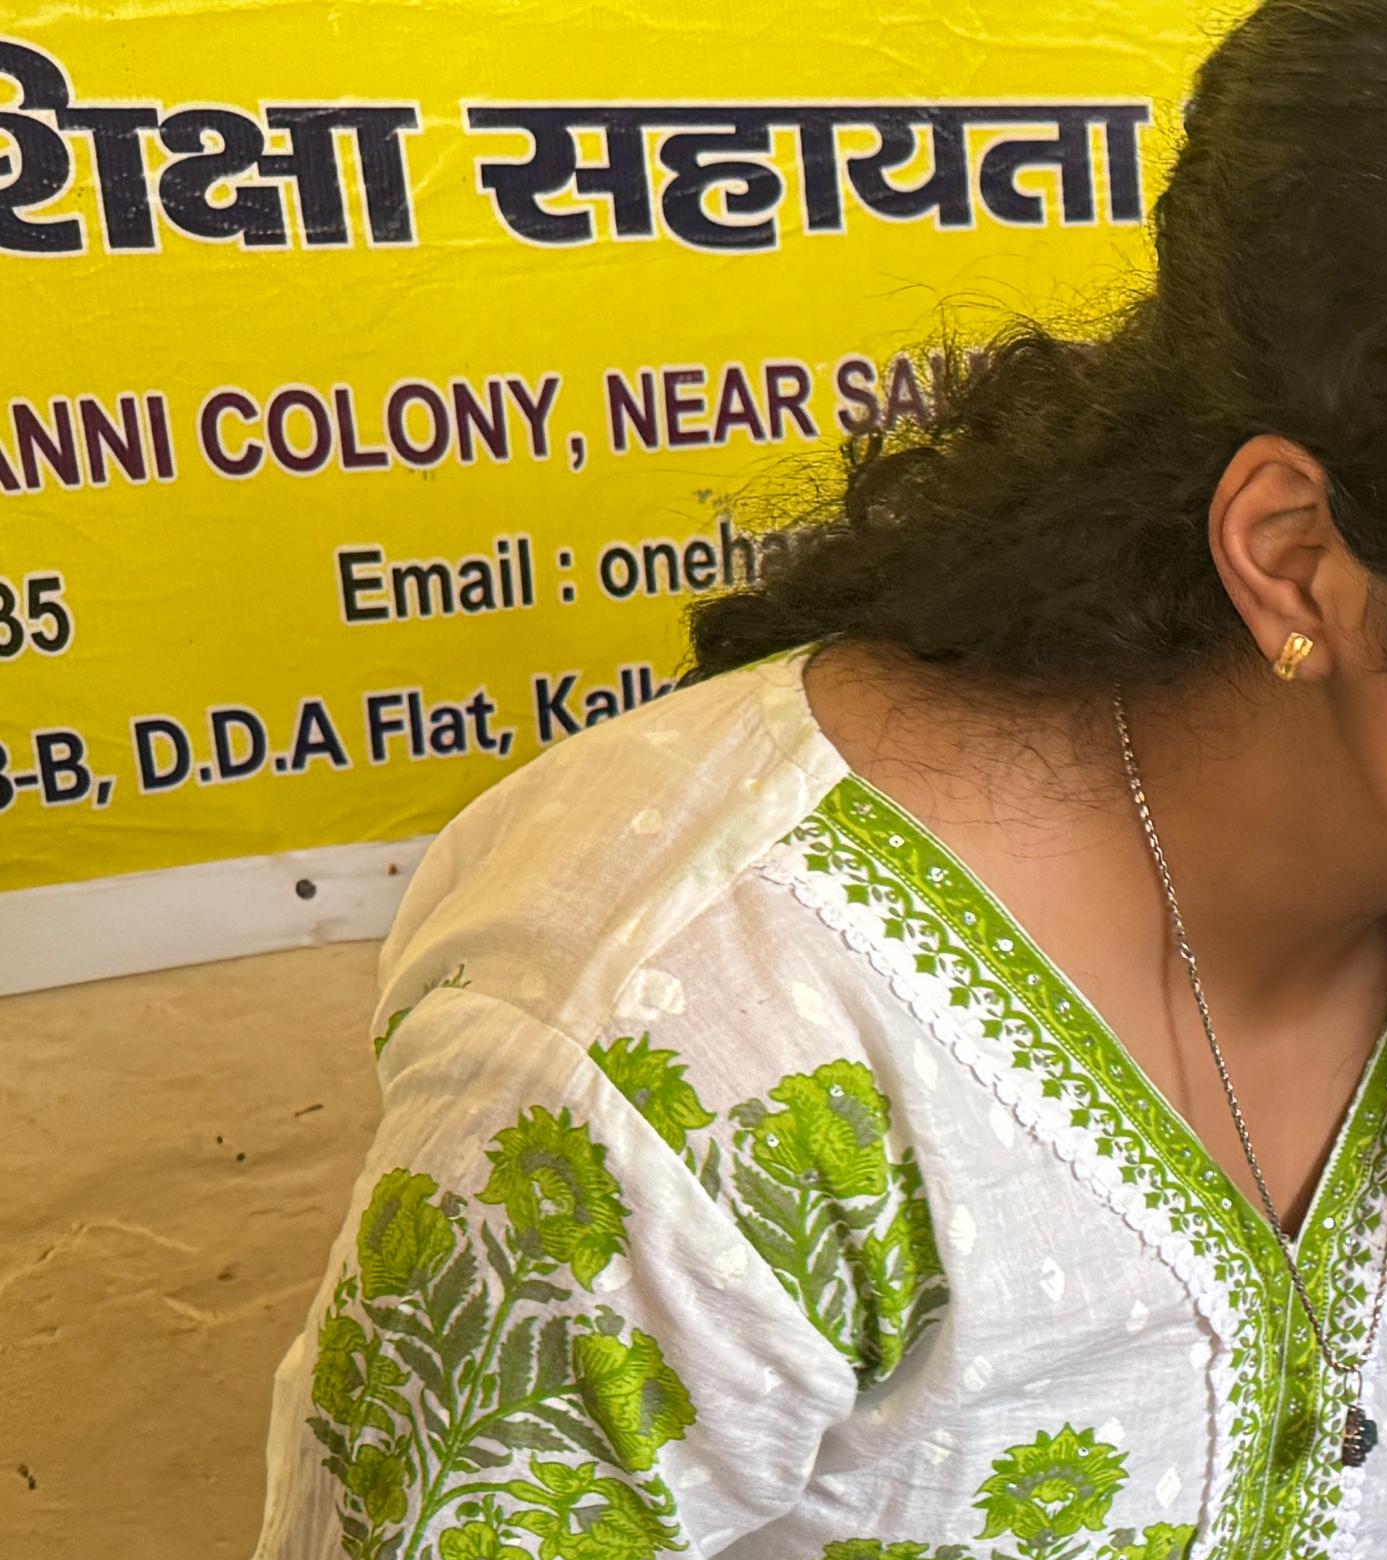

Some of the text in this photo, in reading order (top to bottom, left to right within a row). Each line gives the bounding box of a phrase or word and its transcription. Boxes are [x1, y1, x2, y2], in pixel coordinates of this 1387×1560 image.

[463, 102, 1149, 248] सहायता
[200, 372, 586, 474] COLONY,
[607, 360, 816, 453] NEAR
[337, 536, 533, 623] Email
[134, 699, 347, 793] D.D.A
[367, 687, 514, 761] Flat,
